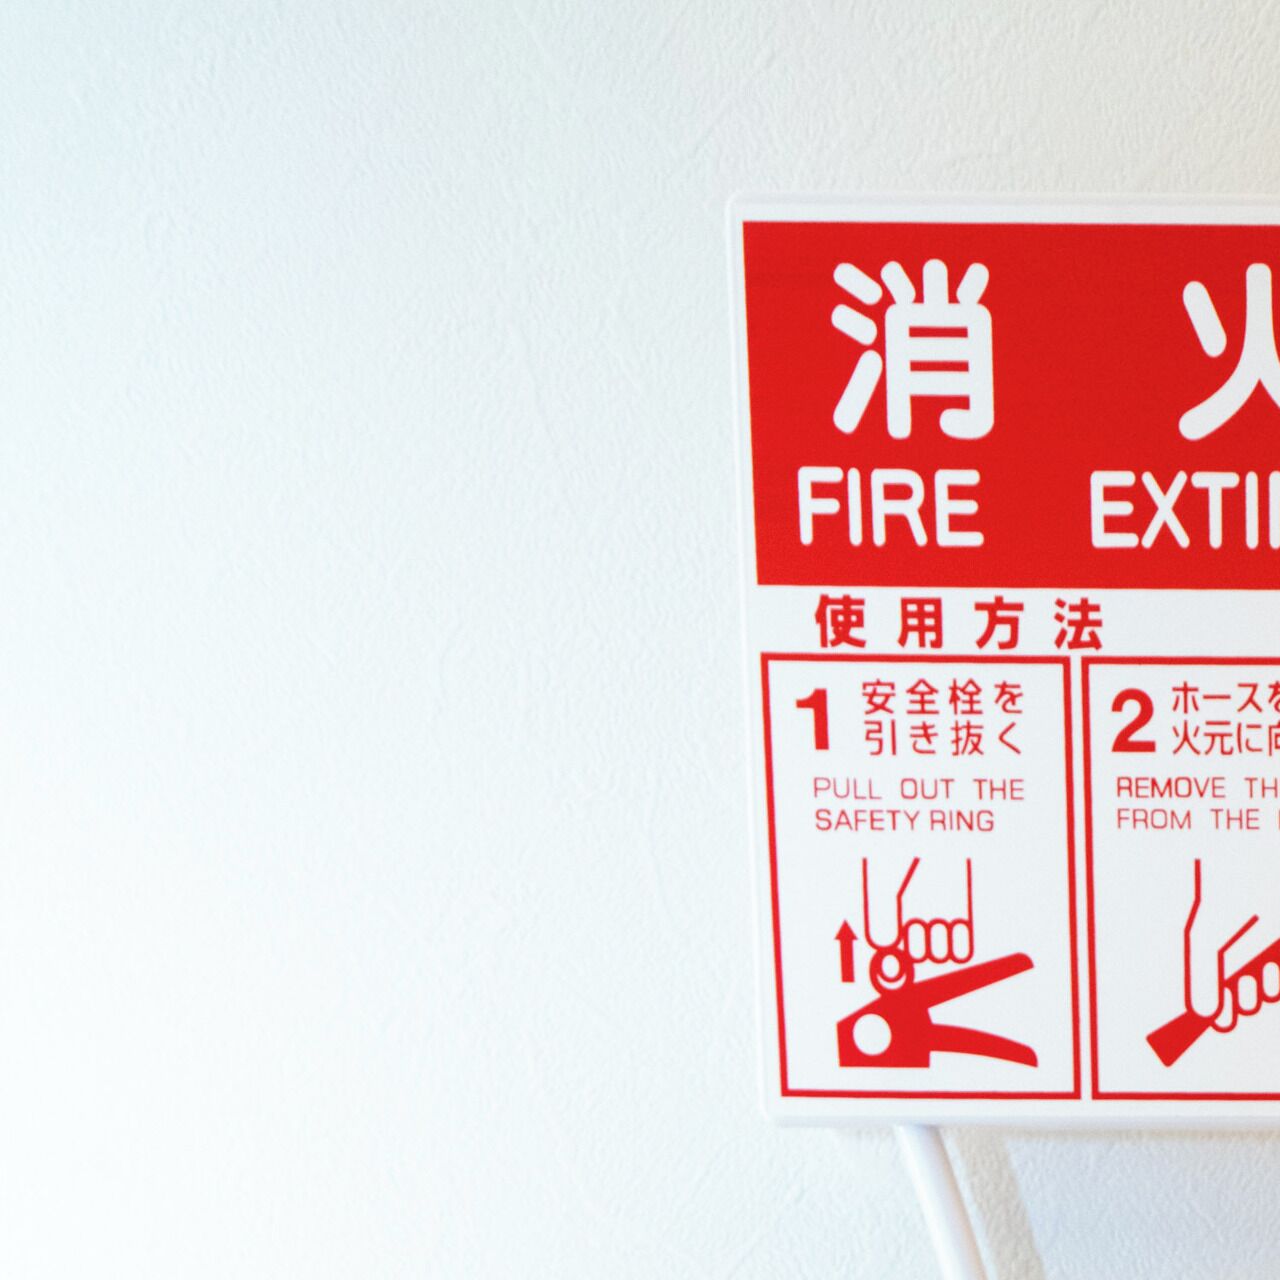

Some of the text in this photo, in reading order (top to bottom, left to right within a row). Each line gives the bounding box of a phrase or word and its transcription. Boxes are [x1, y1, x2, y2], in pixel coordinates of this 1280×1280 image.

[798, 467, 984, 546] FIRE
[809, 593, 1103, 656] 使用方法
[862, 680, 1024, 717] 安全栓を
[795, 688, 830, 751] 1
[865, 719, 1022, 756] 引き抜く
[1111, 688, 1157, 753] 2
[813, 777, 1023, 800] PULL OUT THE
[1116, 776, 1224, 799] REMOVE
[815, 809, 995, 832] SAFETY RING
[1117, 808, 1191, 830] FROM
[1212, 808, 1259, 830] THE
